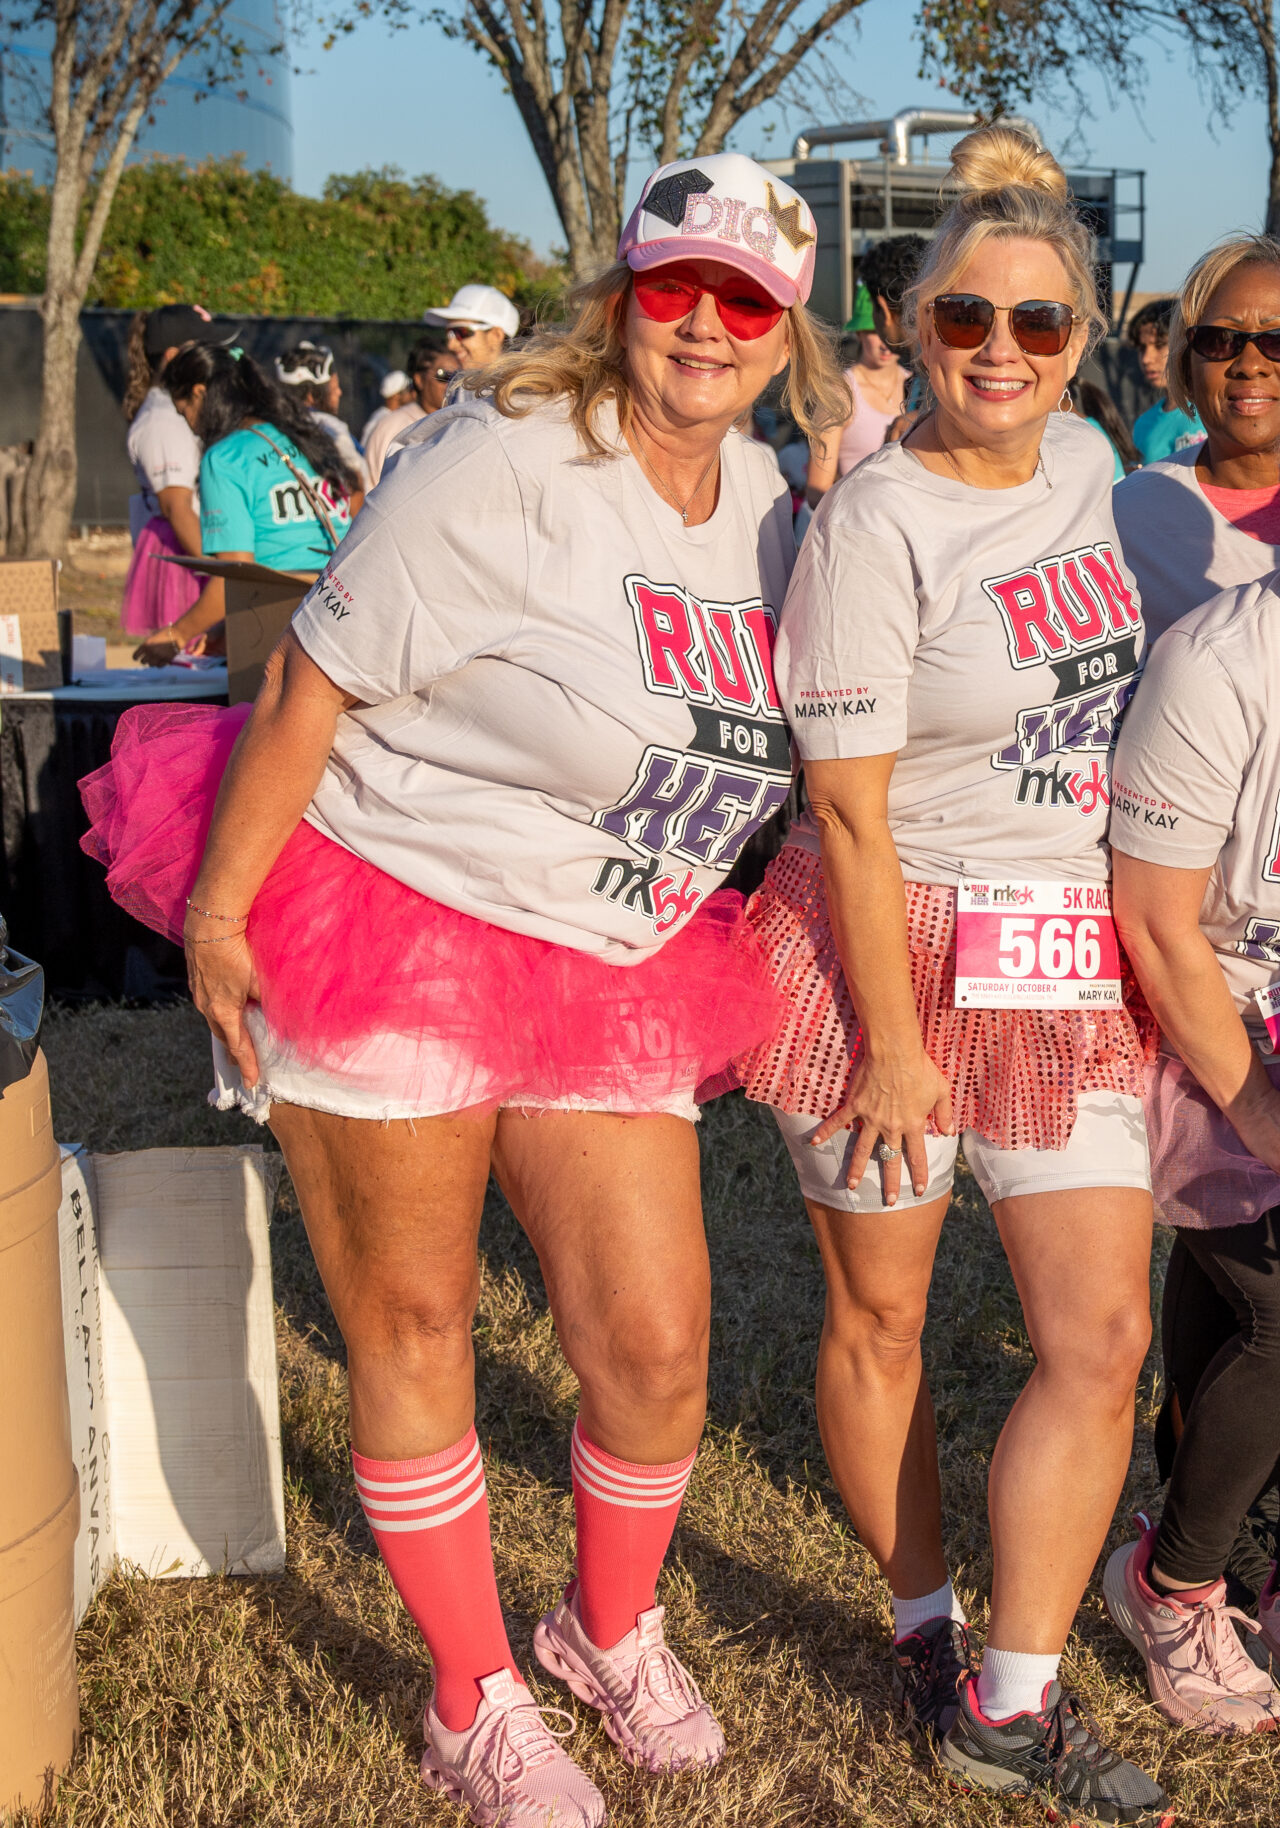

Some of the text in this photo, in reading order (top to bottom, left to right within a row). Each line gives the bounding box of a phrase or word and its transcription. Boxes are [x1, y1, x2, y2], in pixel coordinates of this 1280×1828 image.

[682, 192, 777, 262] DIQ
[322, 592, 350, 621] KAY
[344, 591, 354, 603] BY
[981, 542, 1142, 670] RUN
[1078, 652, 1118, 685] FOR
[800, 686, 869, 699] PRESENTED BY
[795, 698, 877, 718] MARY KAY
[719, 719, 768, 759] FOR
[1114, 780, 1174, 811] PRESENTED BY
[1144, 809, 1179, 830] KAY
[1063, 887, 1083, 909] 5K
[998, 917, 1101, 978] 566
[967, 982, 1009, 992] SATURDAY
[1017, 983, 1050, 993] OCTOBER
[1052, 983, 1057, 993] 4
[1079, 990, 1117, 1001] MARY KAY
